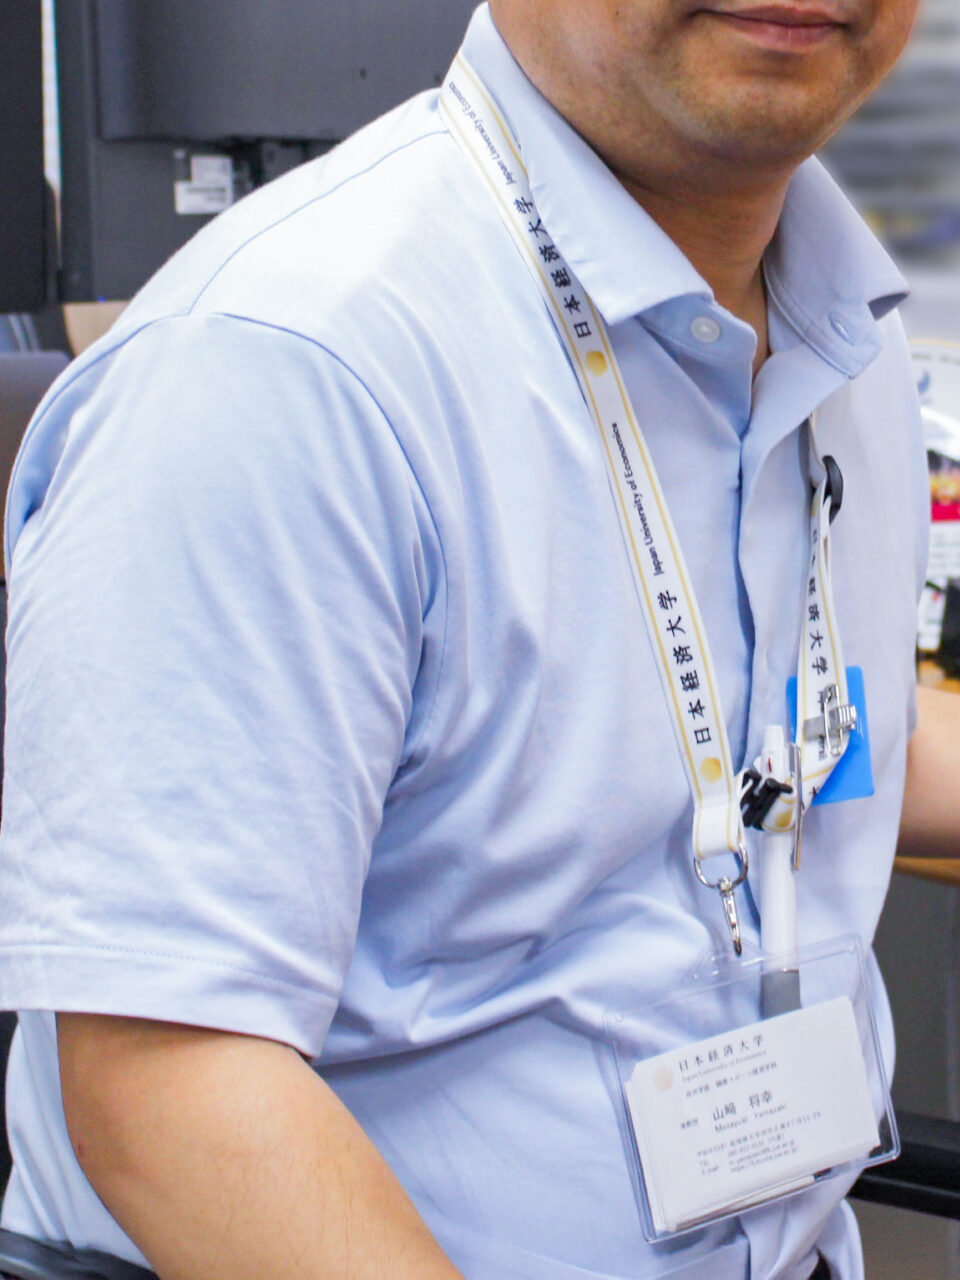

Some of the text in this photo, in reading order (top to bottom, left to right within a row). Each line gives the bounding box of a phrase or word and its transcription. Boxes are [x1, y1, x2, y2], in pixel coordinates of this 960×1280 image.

[513, 196, 592, 339] 日本経済大学
[611, 422, 665, 577] Japan University of Economics
[658, 589, 712, 745] 日本経済大学
[679, 1034, 763, 1072] 日本経済大学
